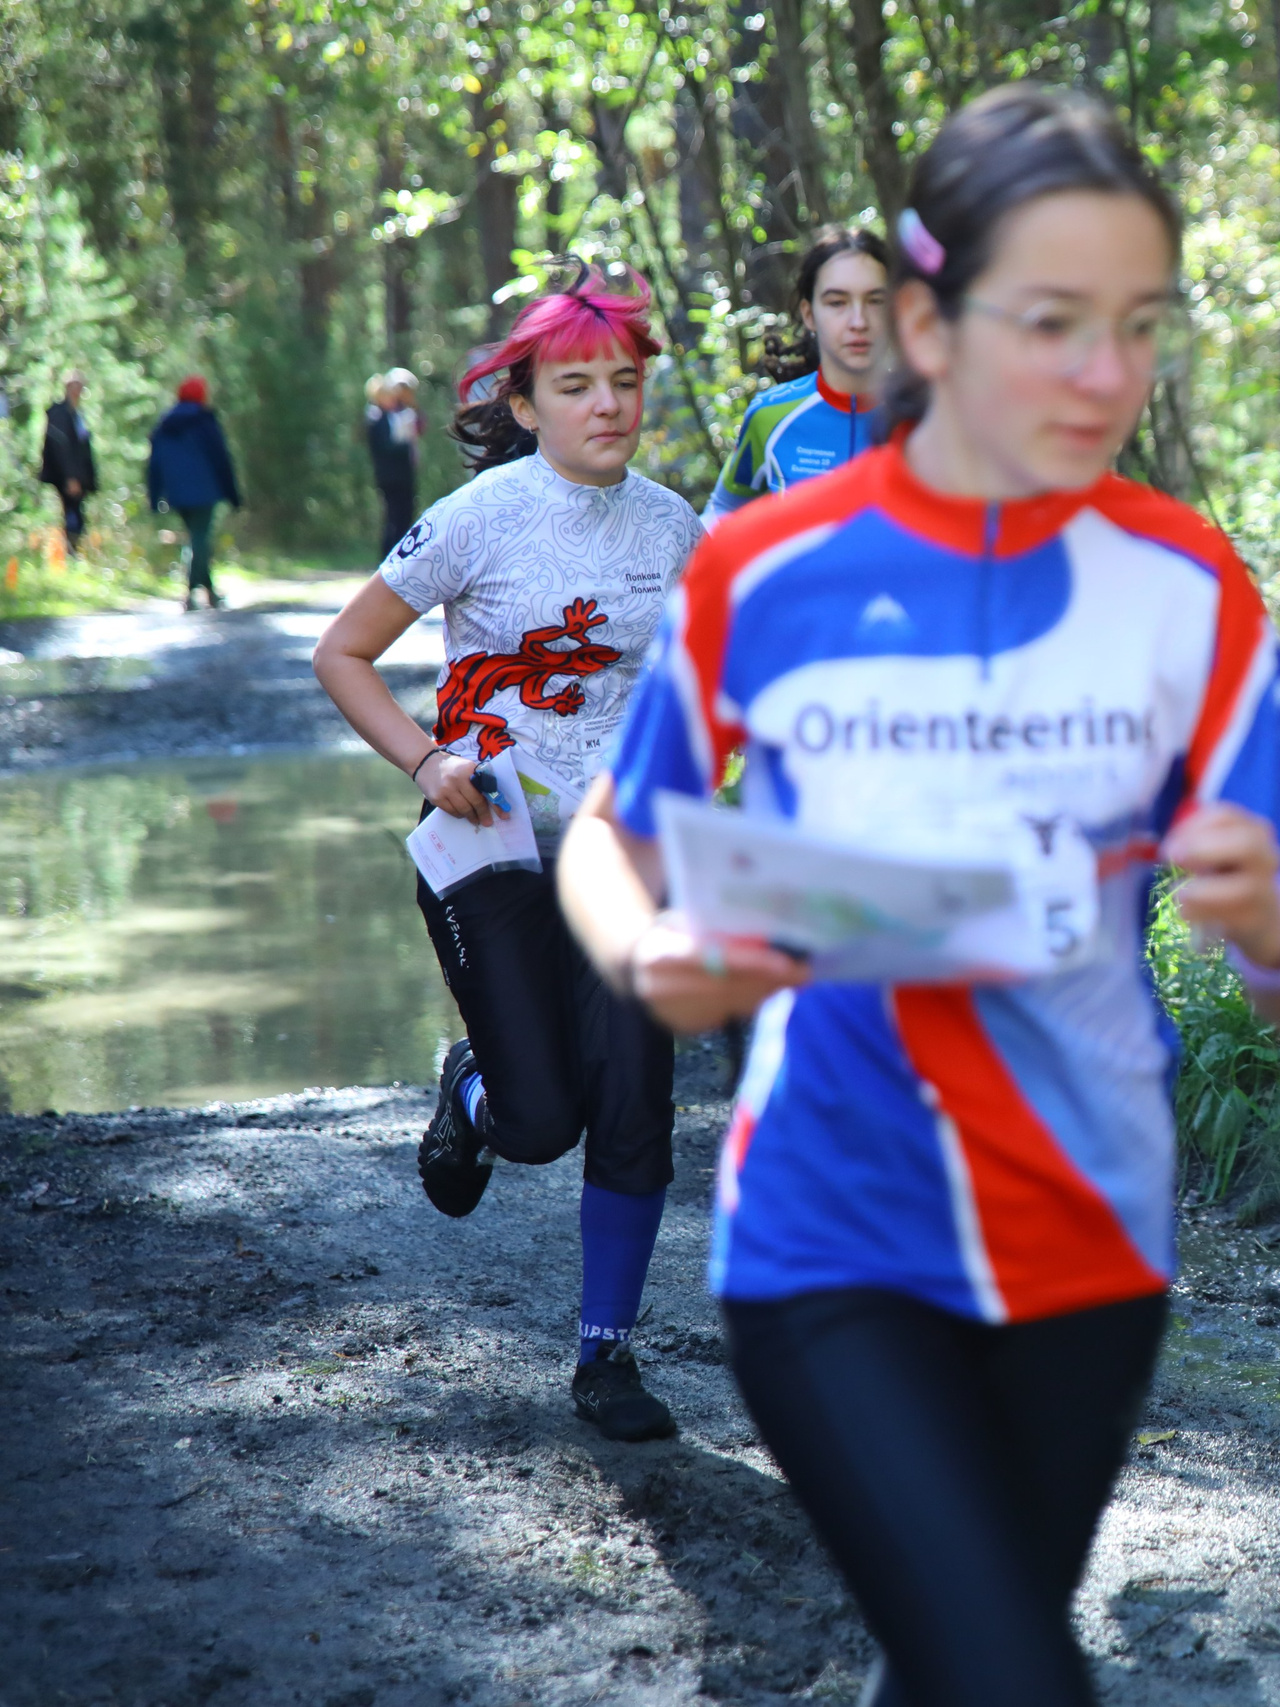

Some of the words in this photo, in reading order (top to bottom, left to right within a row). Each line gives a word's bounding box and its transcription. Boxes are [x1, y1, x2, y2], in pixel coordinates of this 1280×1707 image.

[625, 572, 661, 582] Попкова
[631, 585, 662, 594] Полина
[579, 1321, 631, 1341] IPST
